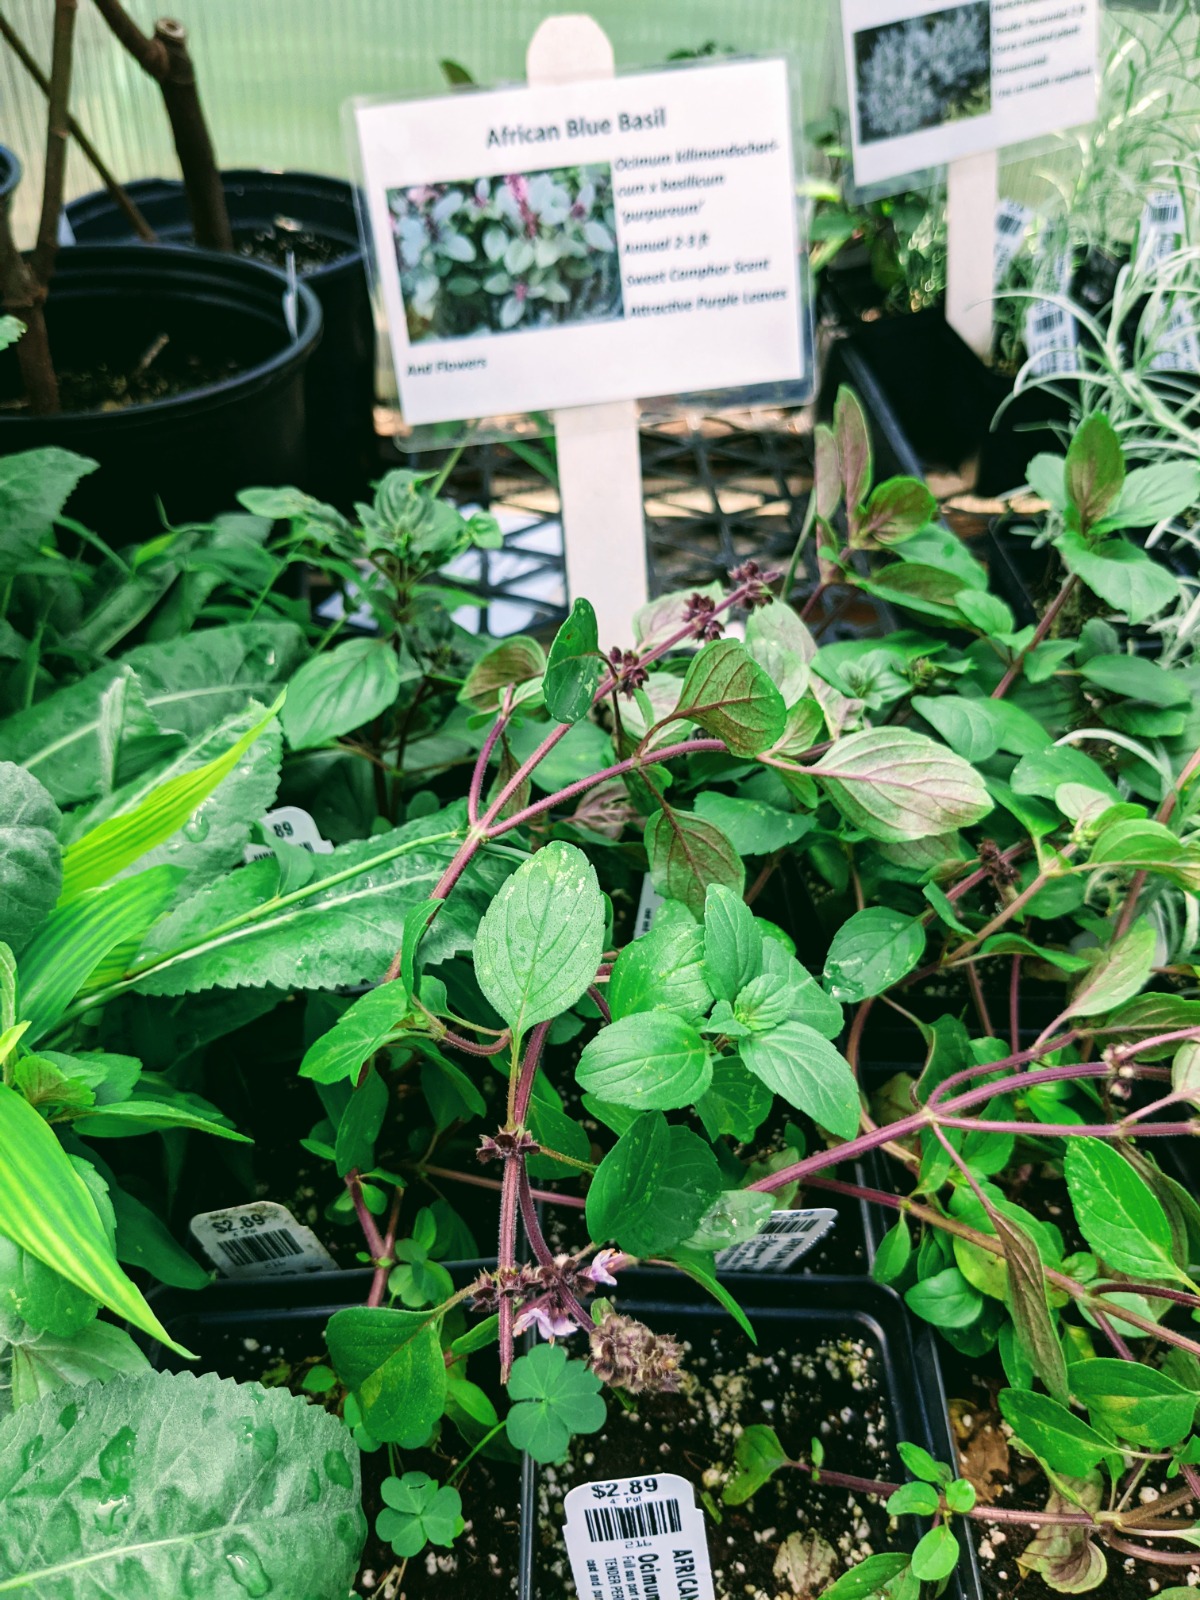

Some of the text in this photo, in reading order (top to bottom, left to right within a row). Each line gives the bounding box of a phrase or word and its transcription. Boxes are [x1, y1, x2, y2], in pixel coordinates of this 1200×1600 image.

[487, 106, 667, 149] African Blue Basil
[615, 153, 672, 172] Ocimum
[626, 271, 666, 288] Sweet
[437, 358, 486, 373] Flowers
[212, 1213, 266, 1234] $2.89
[591, 1477, 659, 1500] $2.89
[604, 1557, 622, 1585] TENDER
